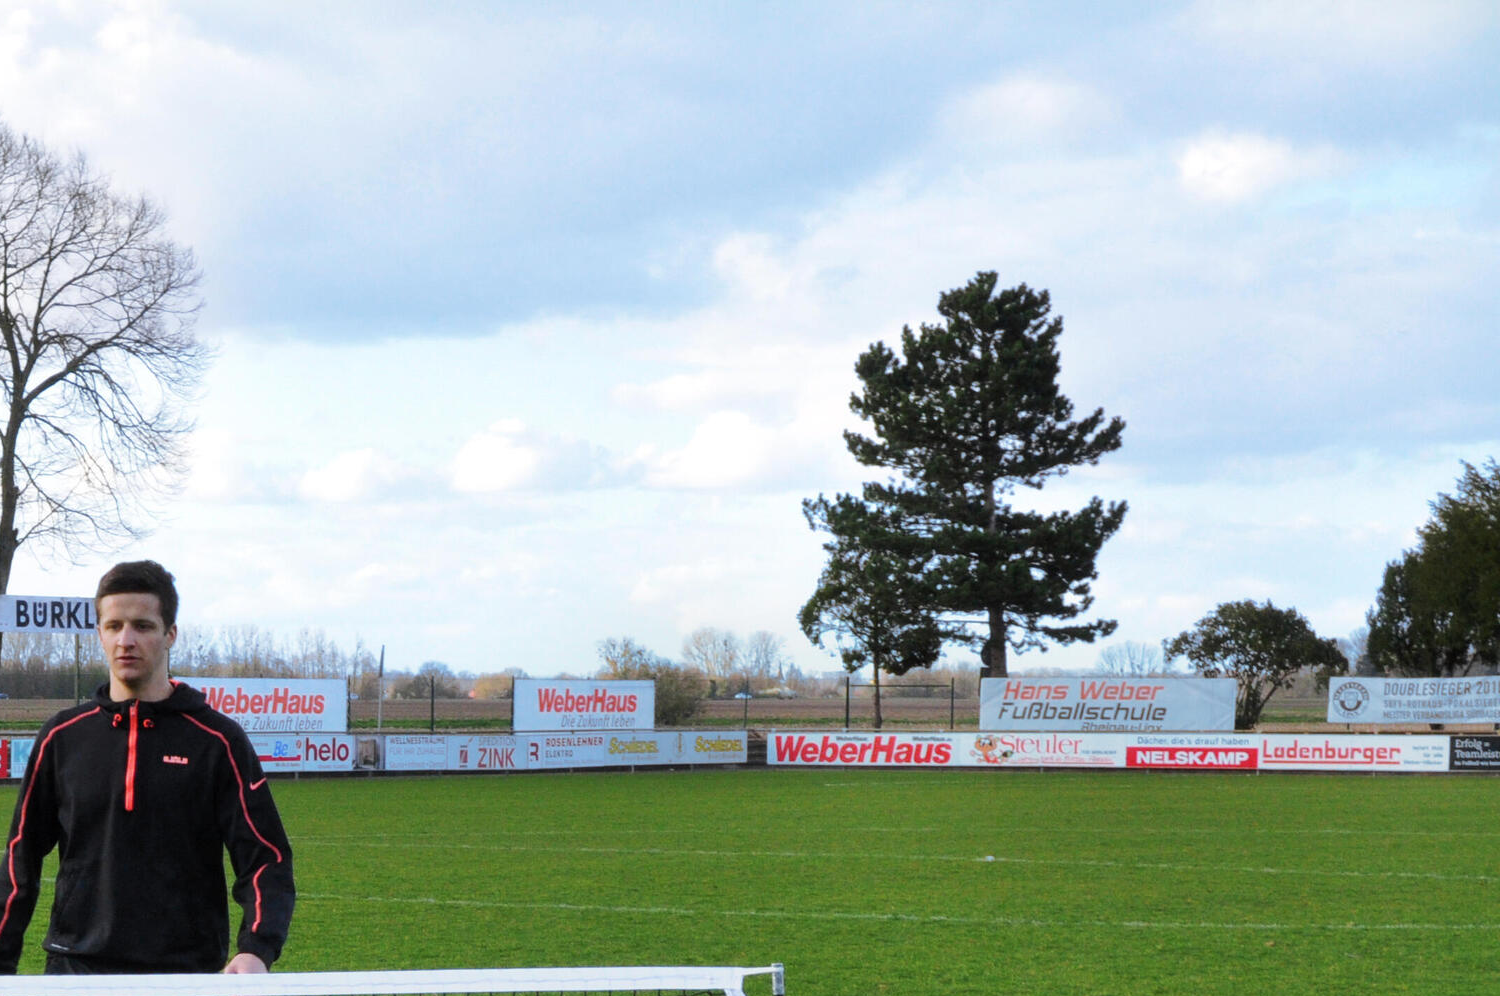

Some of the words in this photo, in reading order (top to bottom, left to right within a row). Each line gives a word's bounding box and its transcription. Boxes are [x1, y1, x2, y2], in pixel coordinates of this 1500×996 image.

[1003, 681, 1069, 700] Hans
[1080, 681, 1164, 700] Weber
[1383, 682, 1471, 696] DOUBLESIEGER
[201, 687, 325, 715] WeberHaus
[538, 688, 637, 713] WeberHaus
[998, 702, 1167, 721] Fußballschule
[252, 716, 293, 731] Zukunft
[295, 717, 323, 730] leben
[561, 715, 575, 728] Die
[577, 715, 610, 728] Zukunft
[611, 715, 635, 728] leben
[305, 737, 349, 761] helo
[775, 735, 952, 764] WeberHaus
[1000, 734, 1083, 755] Steuler
[1194, 737, 1220, 745] drauf
[1220, 737, 1250, 745] haben
[1455, 738, 1482, 750] Erfolg
[477, 748, 515, 768] ZINK
[1136, 750, 1250, 765] NELSKAMP
[1263, 740, 1401, 763] Ladenburger
